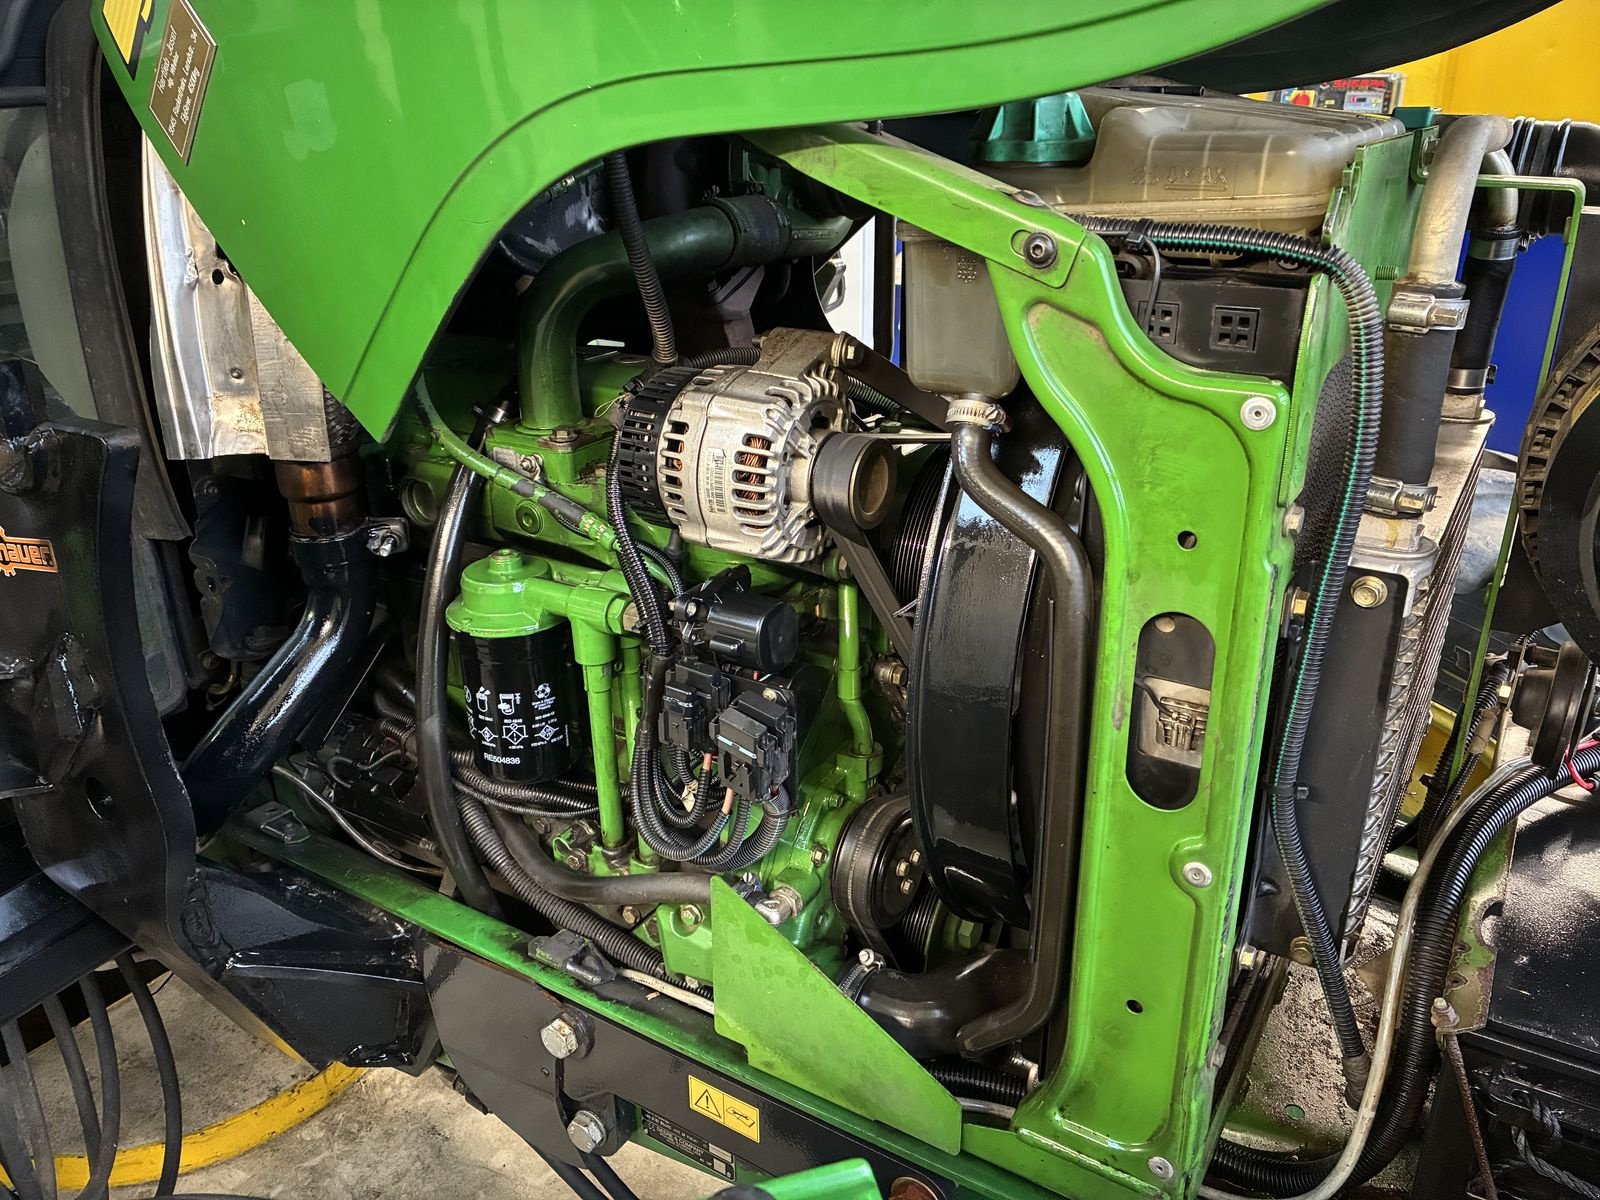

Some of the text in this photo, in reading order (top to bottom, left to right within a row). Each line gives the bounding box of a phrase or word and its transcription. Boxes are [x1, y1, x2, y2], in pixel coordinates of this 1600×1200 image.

[166, 25, 177, 56] Josef
[1333, 79, 1386, 89] SHERPA
[483, 752, 521, 764] RE504836
